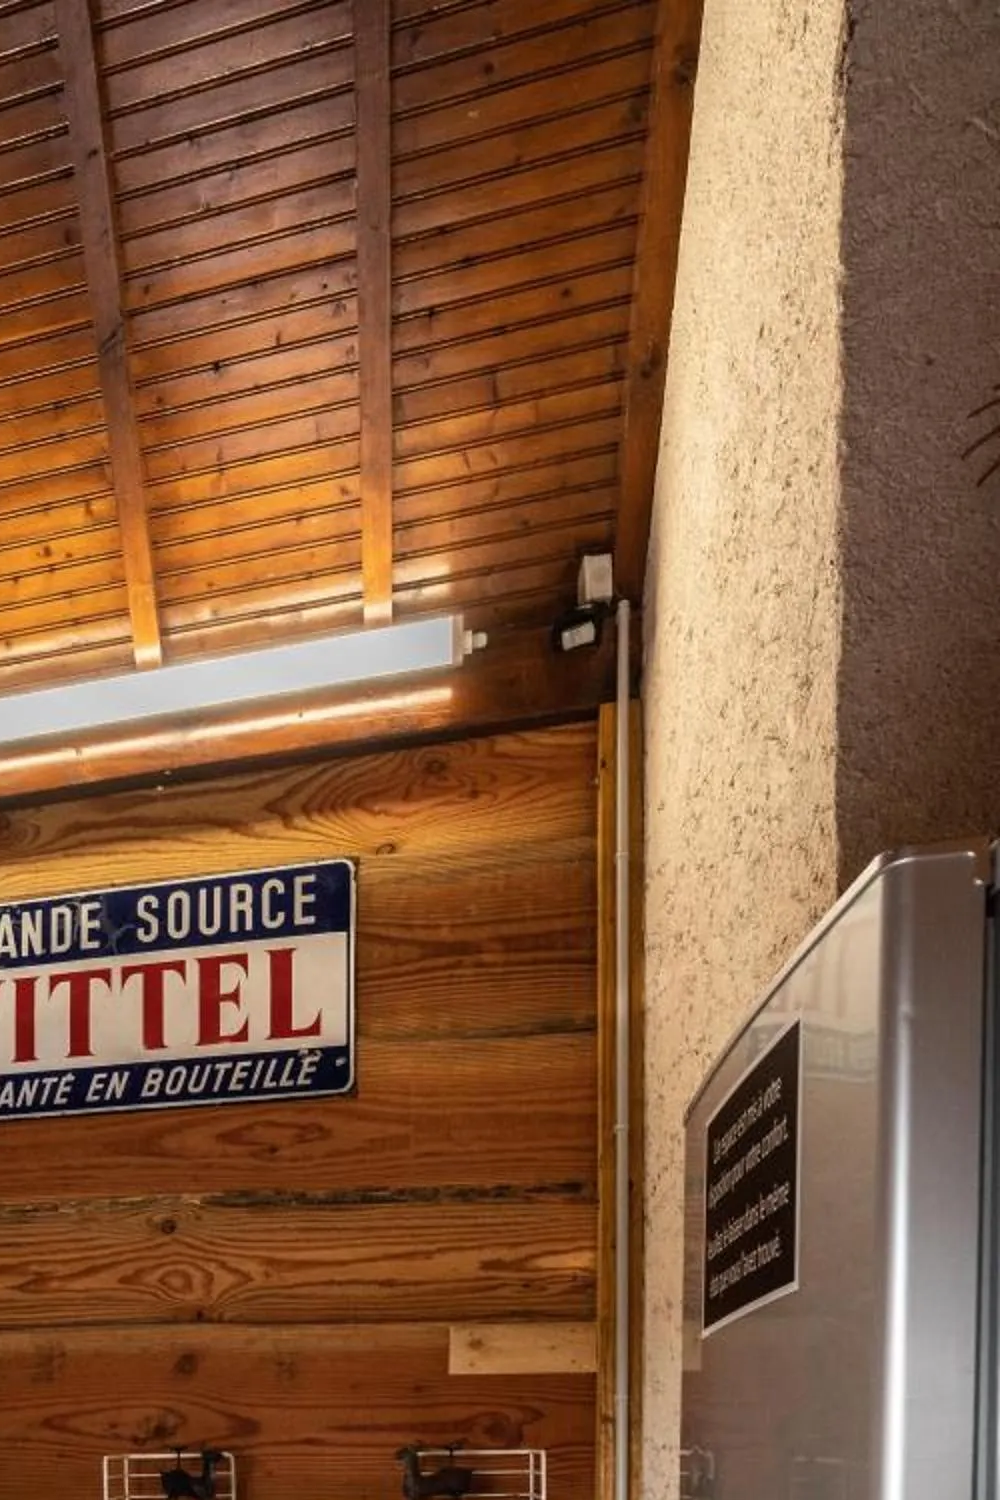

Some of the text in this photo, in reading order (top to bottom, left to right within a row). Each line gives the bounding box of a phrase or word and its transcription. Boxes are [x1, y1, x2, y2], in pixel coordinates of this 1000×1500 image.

[136, 874, 316, 944] SOURCE
[86, 1071, 130, 1101] EN
[142, 1056, 317, 1097] BOUTEILLE
